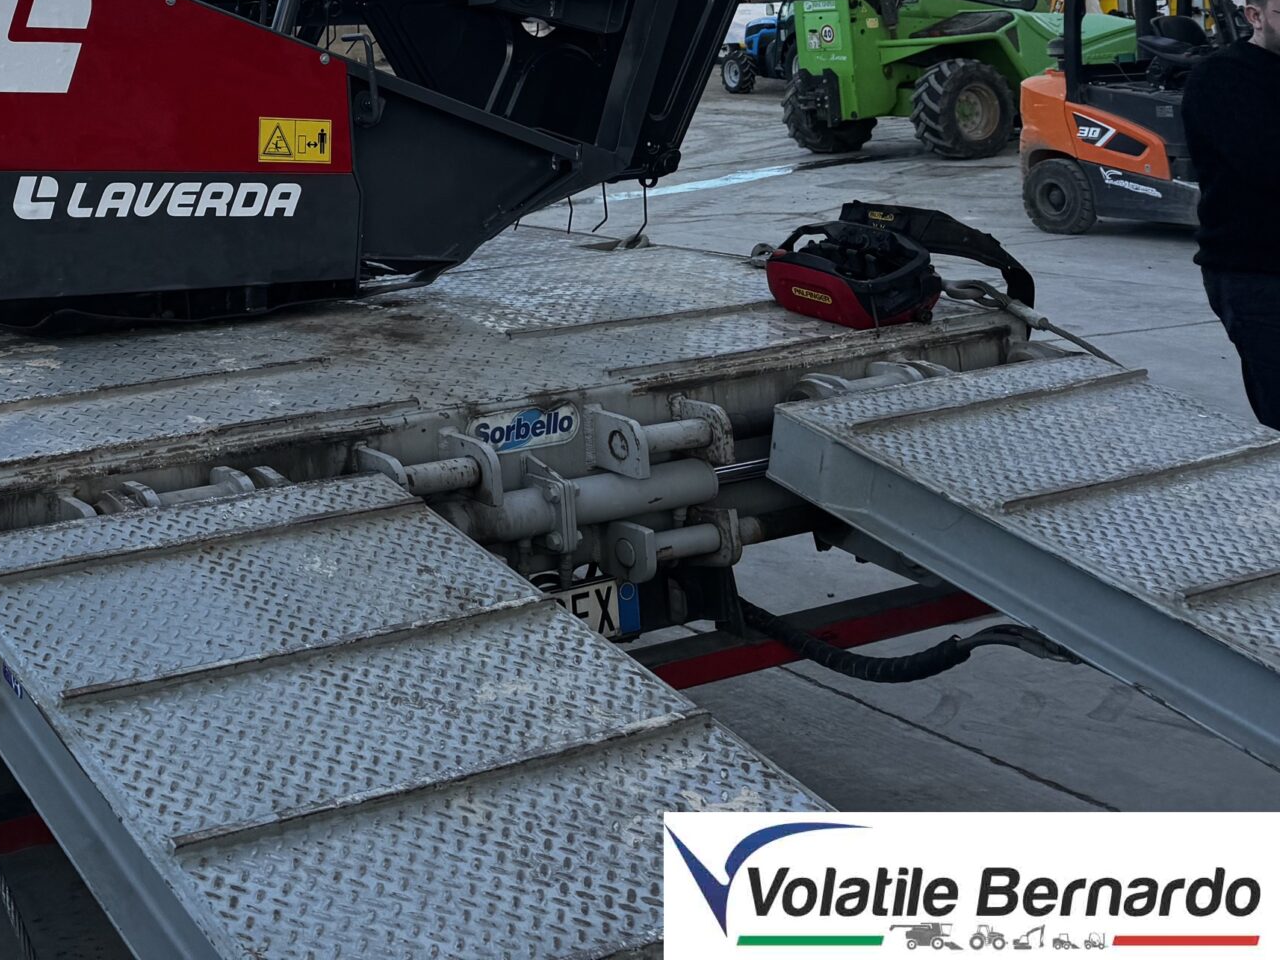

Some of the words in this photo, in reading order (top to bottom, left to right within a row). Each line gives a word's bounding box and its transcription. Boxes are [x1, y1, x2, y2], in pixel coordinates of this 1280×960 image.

[823, 31, 832, 39] 40
[67, 182, 302, 218] LAVERDA
[475, 411, 573, 444] Sorbello
